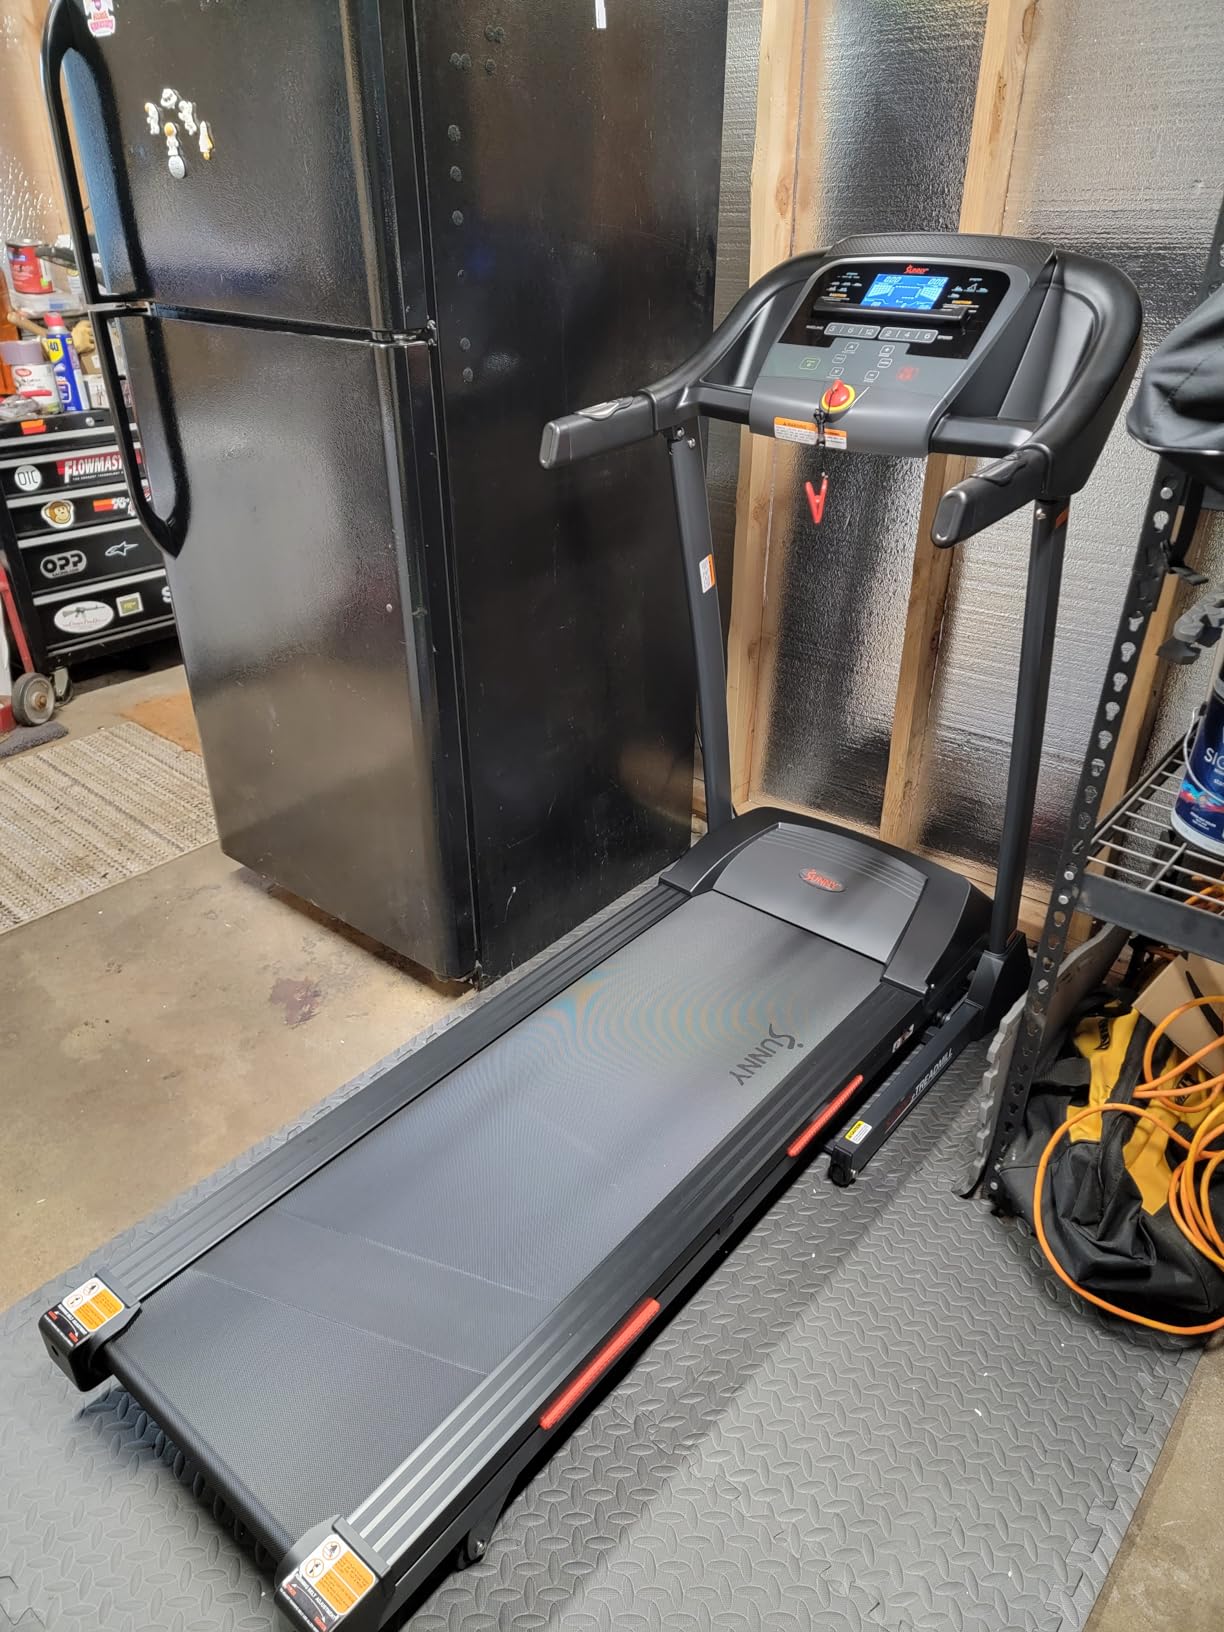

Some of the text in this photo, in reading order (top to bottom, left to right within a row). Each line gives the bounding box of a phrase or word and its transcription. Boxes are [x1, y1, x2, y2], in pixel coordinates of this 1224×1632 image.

[923, 332, 931, 340] 6
[64, 455, 123, 484] FLOWMAST
[42, 552, 83, 573] OPP
[729, 1023, 804, 1086] SUNNY
